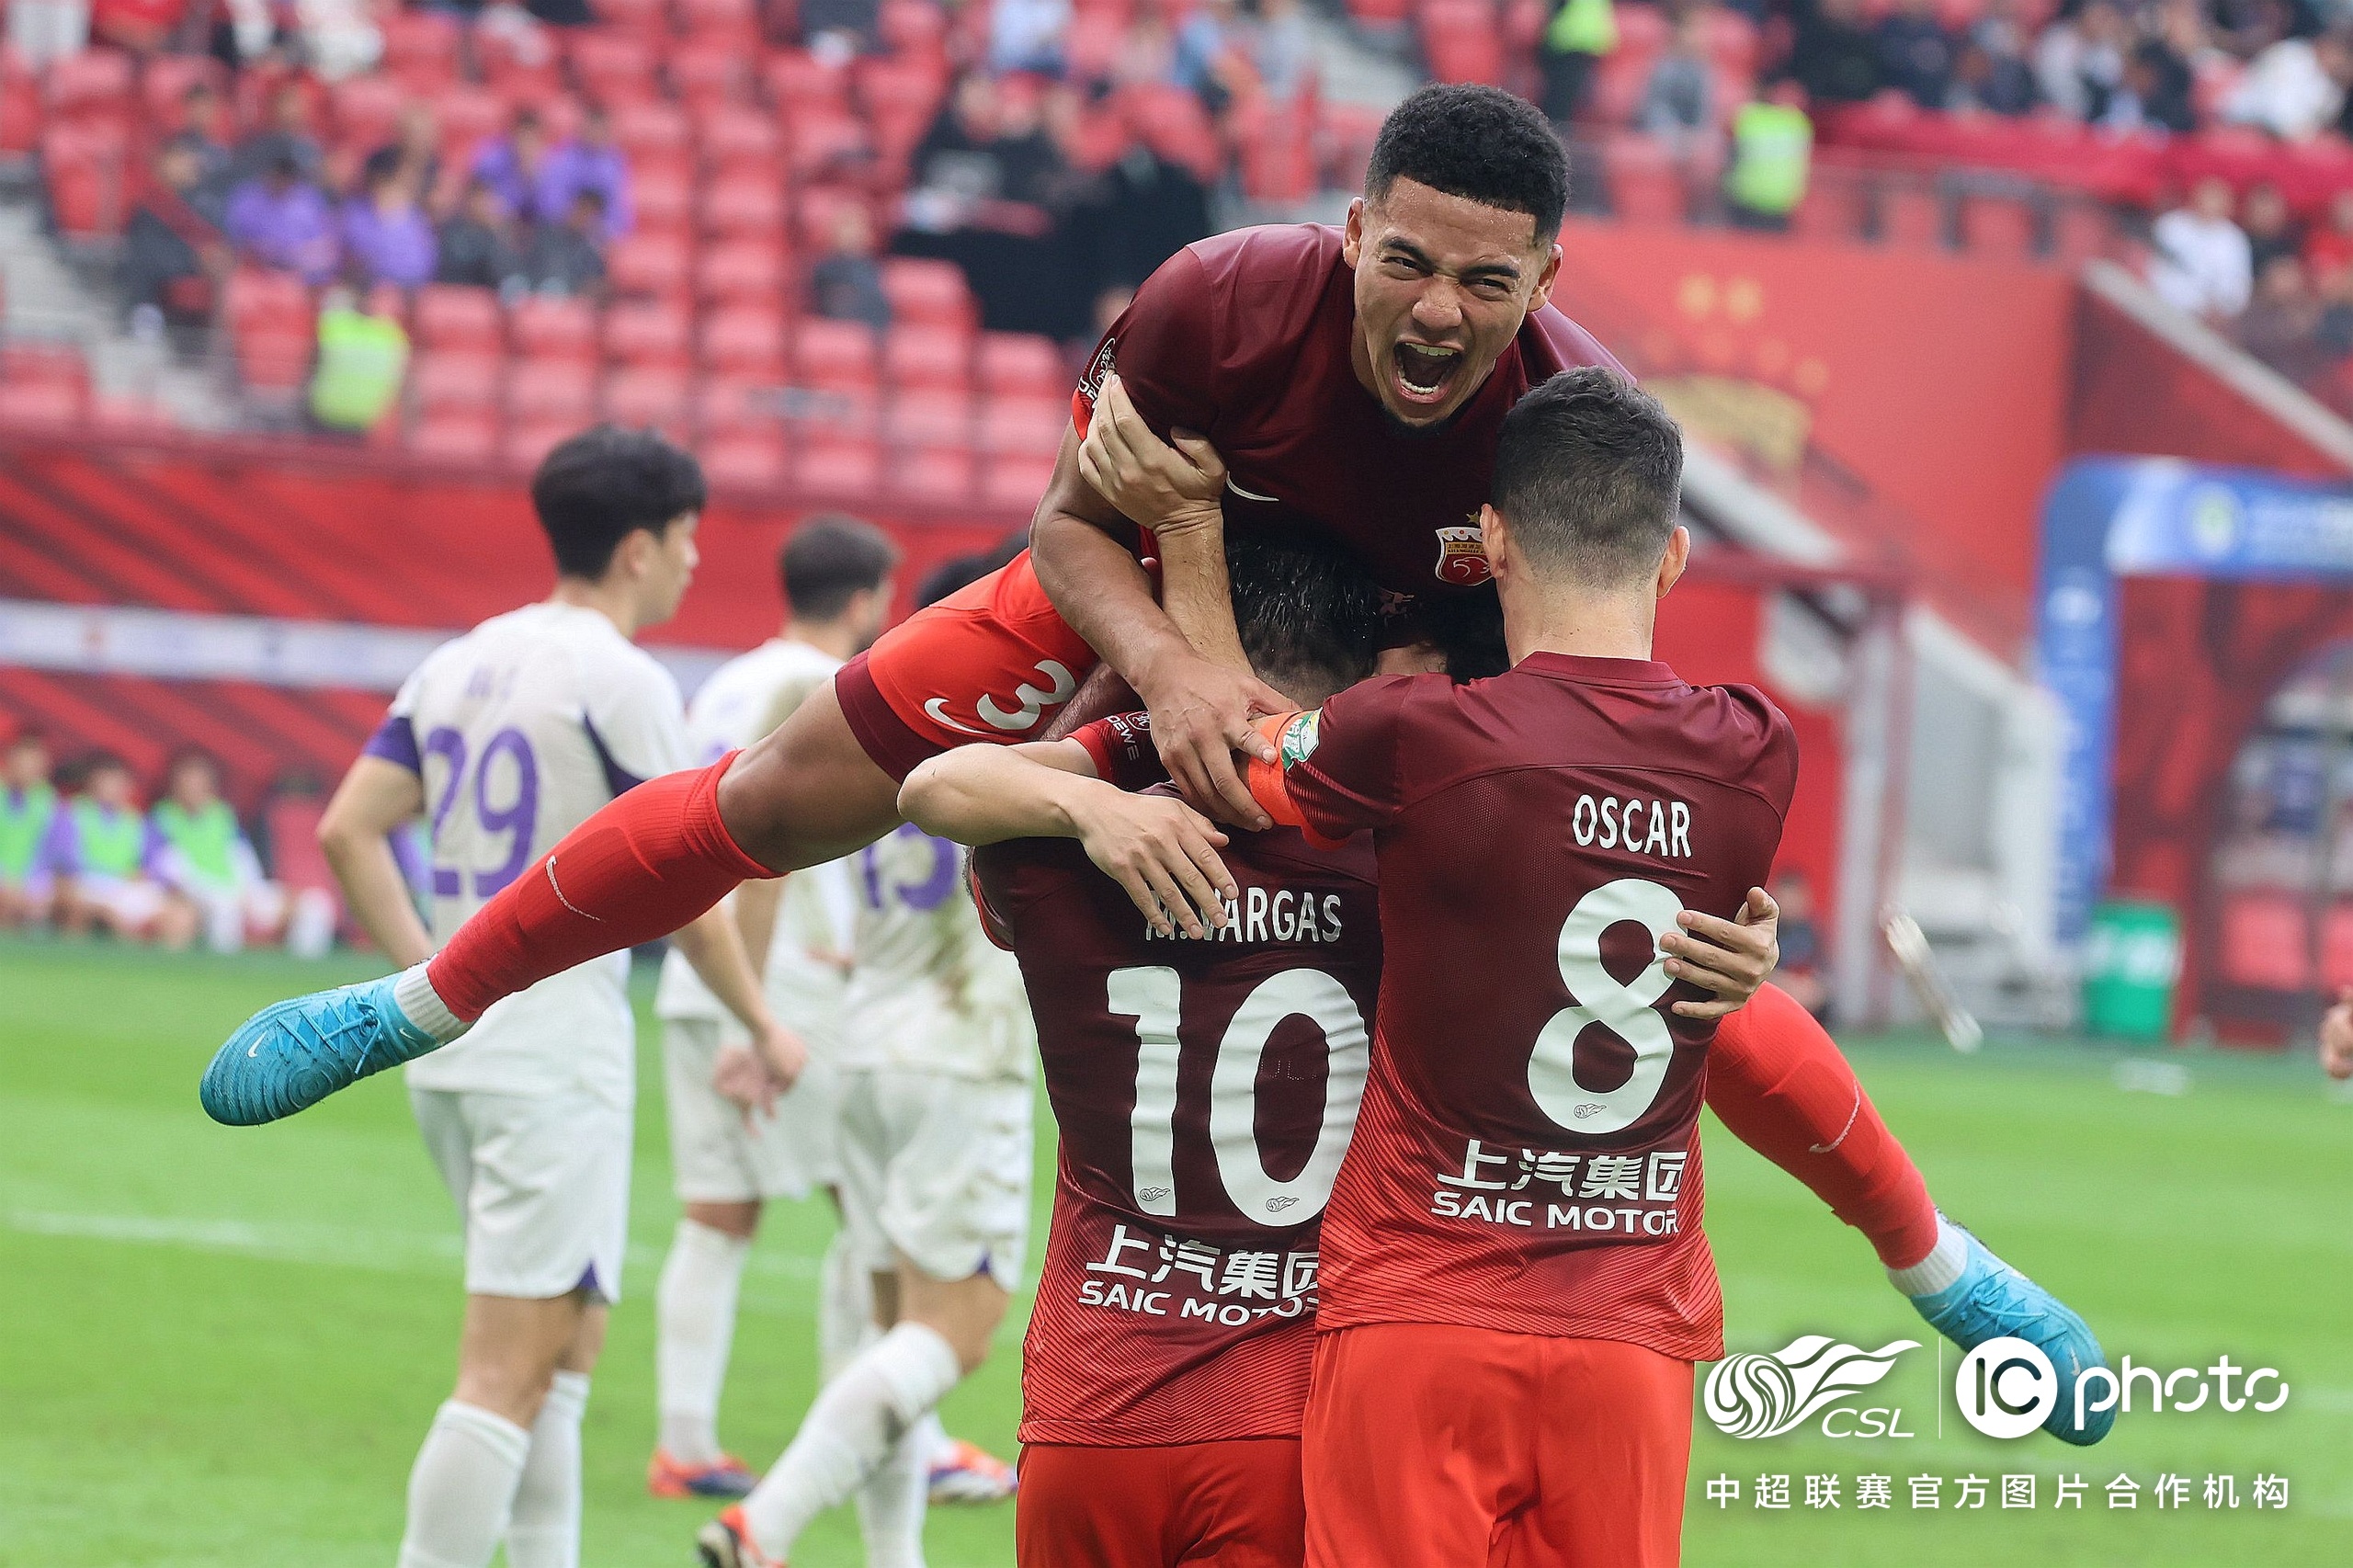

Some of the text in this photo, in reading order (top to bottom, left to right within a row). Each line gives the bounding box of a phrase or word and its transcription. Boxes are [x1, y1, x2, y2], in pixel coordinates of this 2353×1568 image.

[976, 659, 1077, 731] 3
[425, 725, 539, 898] 29
[1571, 793, 1692, 858] OSCAR
[1528, 878, 1688, 1134] 8
[1107, 965, 1371, 1227] 10
[1436, 1138, 1688, 1202] 上汽集团
[1430, 1190, 1680, 1236] SAIC MOTOR
[1077, 1279, 1169, 1316] SAIC
[1086, 1223, 1319, 1301] 上汽集团
